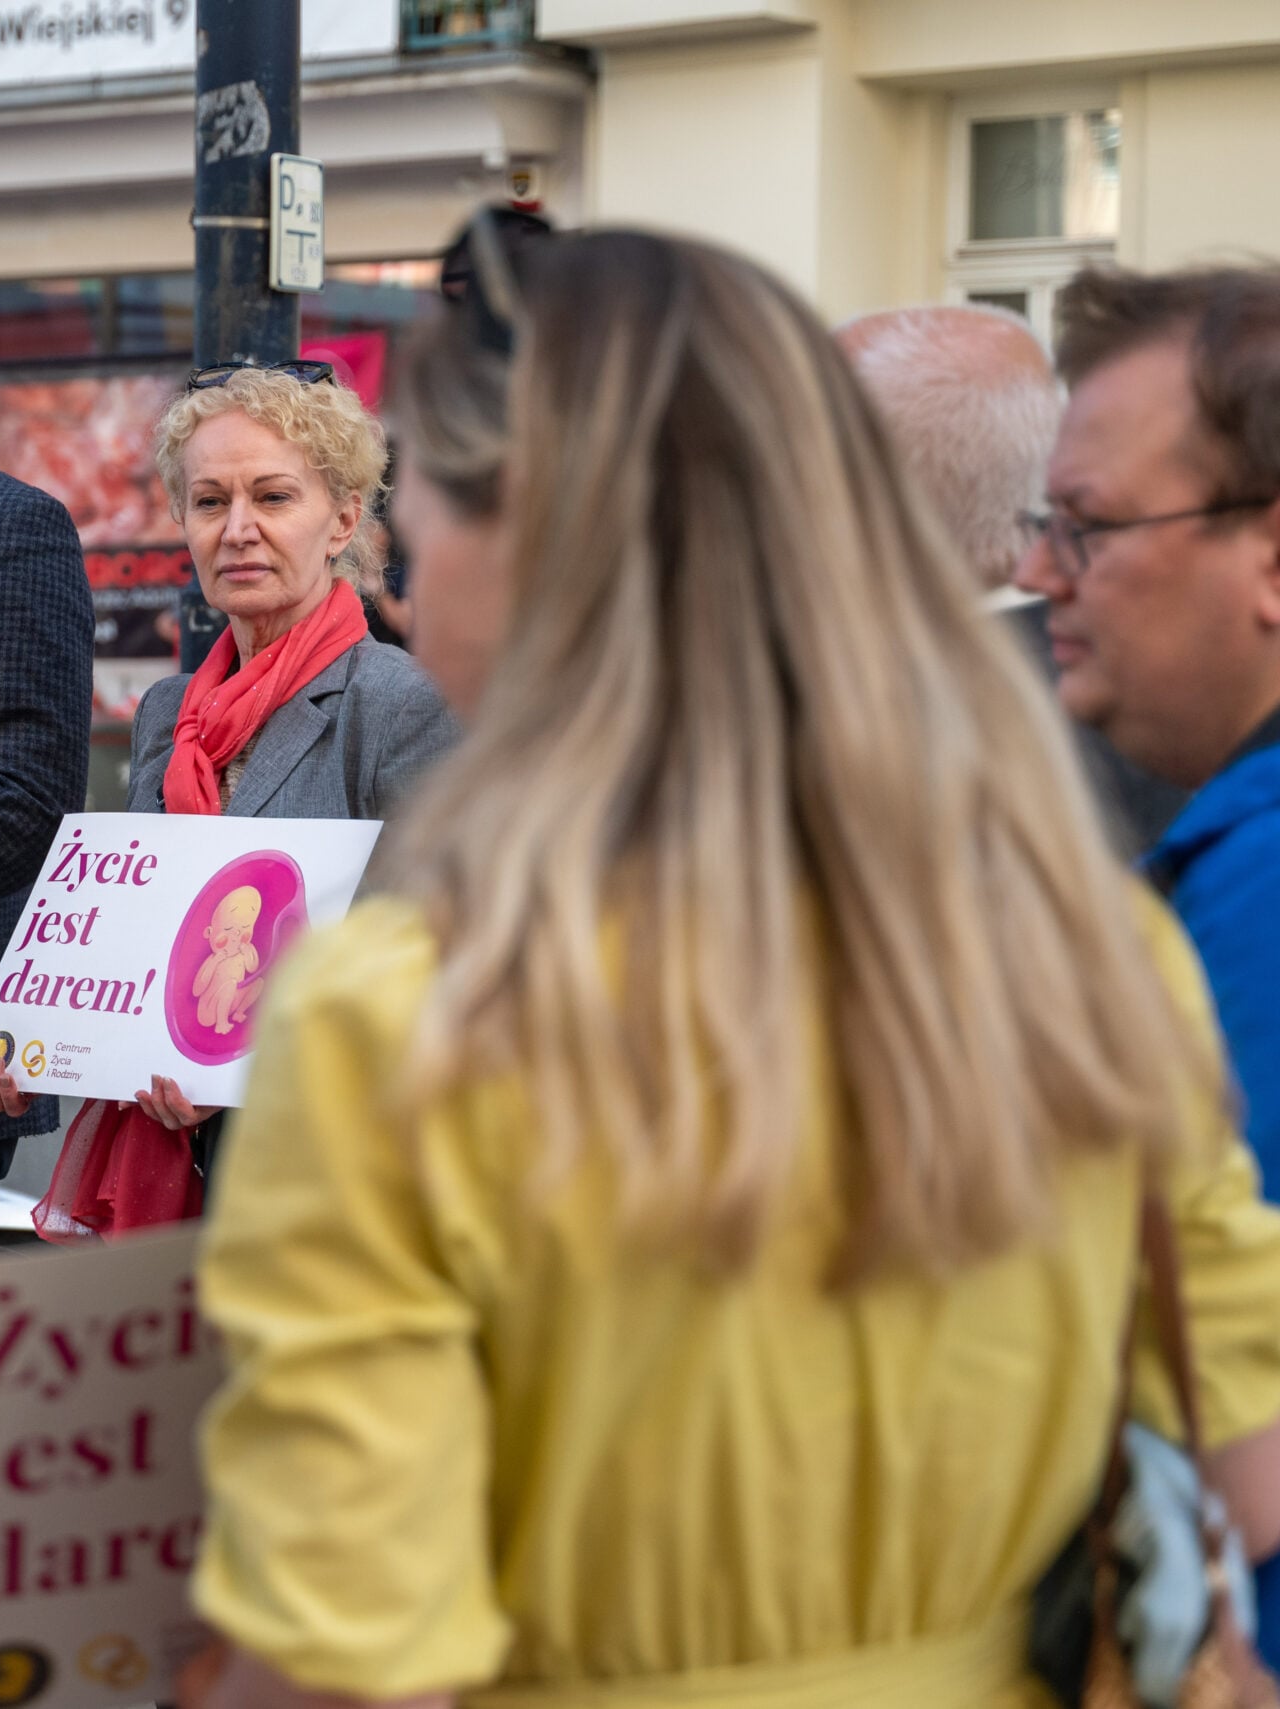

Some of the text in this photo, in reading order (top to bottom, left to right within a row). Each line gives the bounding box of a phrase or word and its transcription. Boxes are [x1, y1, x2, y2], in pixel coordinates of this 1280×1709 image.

[46, 828, 158, 893] Życie
[14, 898, 102, 953] jest
[55, 1042, 91, 1054] Centrum
[50, 1054, 72, 1066] Życia
[51, 1068, 82, 1081] Rodziny
